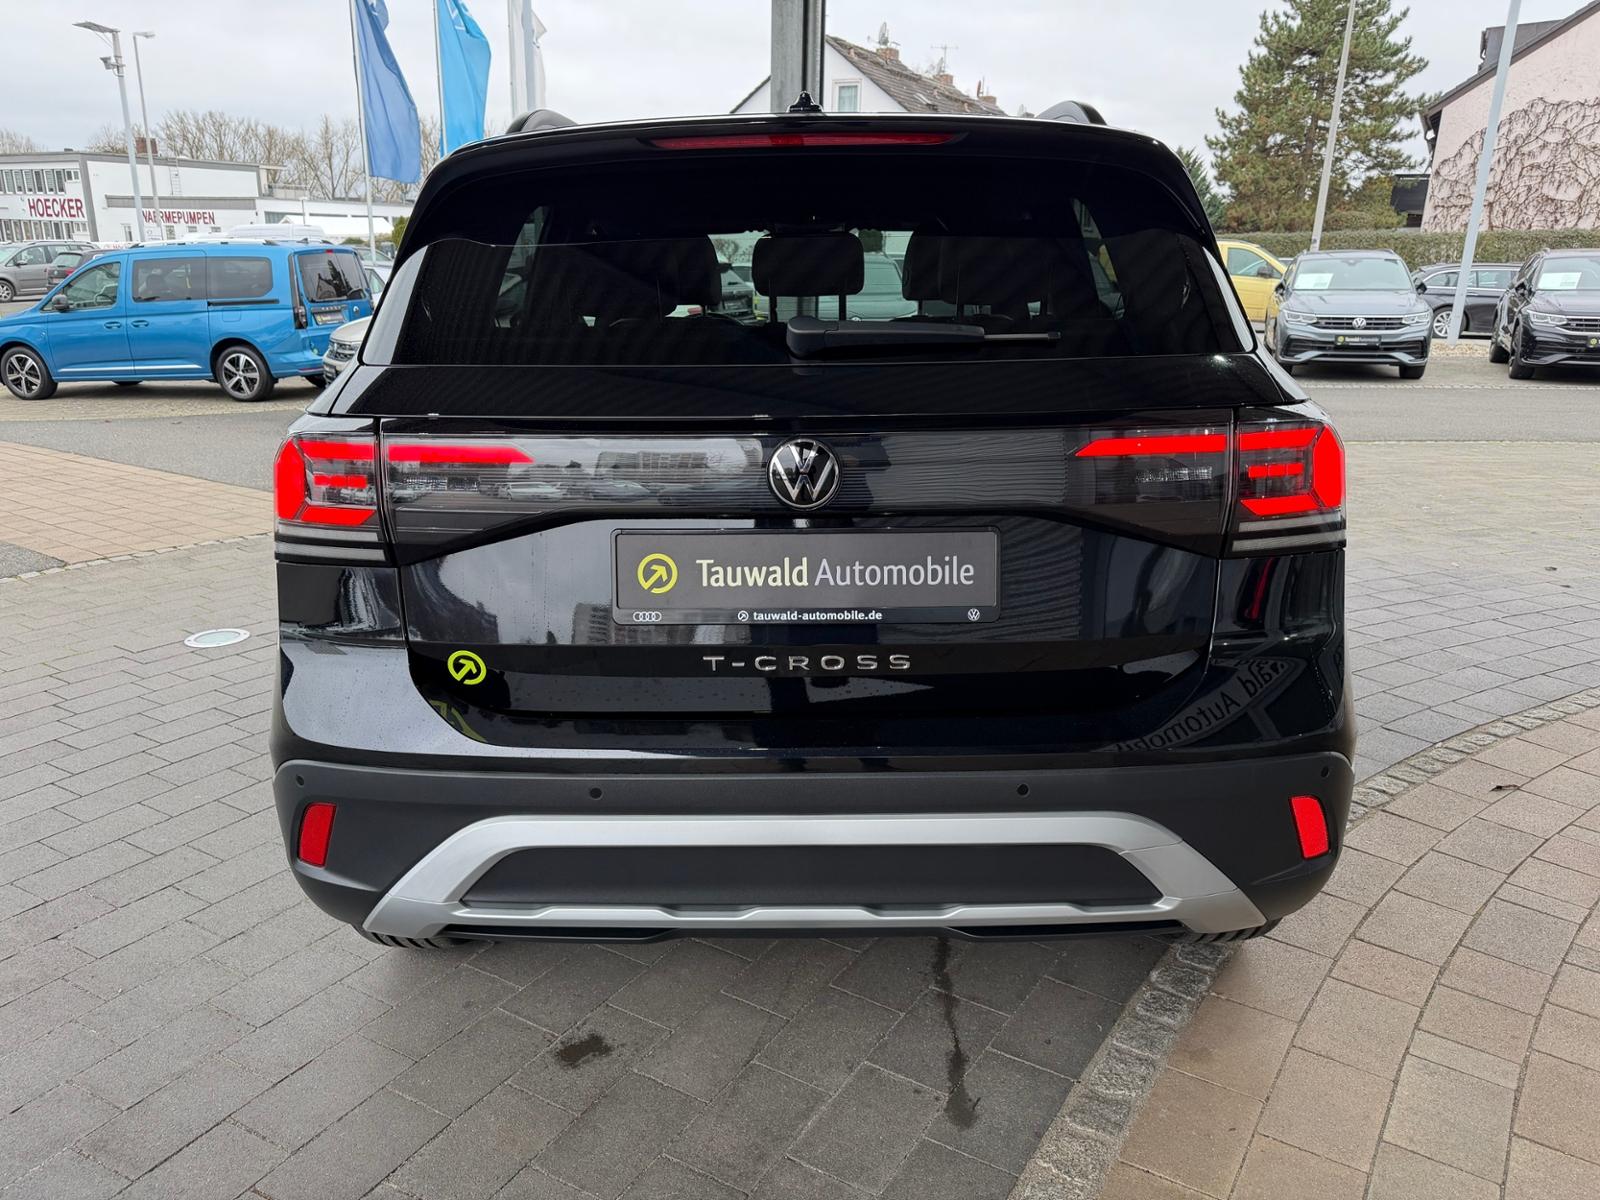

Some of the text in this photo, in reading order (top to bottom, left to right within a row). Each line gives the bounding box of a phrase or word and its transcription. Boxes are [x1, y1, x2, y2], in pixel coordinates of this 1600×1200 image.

[27, 198, 85, 218] HOECKER
[696, 555, 975, 588] Tauwald Automobile
[753, 610, 883, 621] tauwald-automobile.de
[702, 654, 911, 672] T-CROSS
